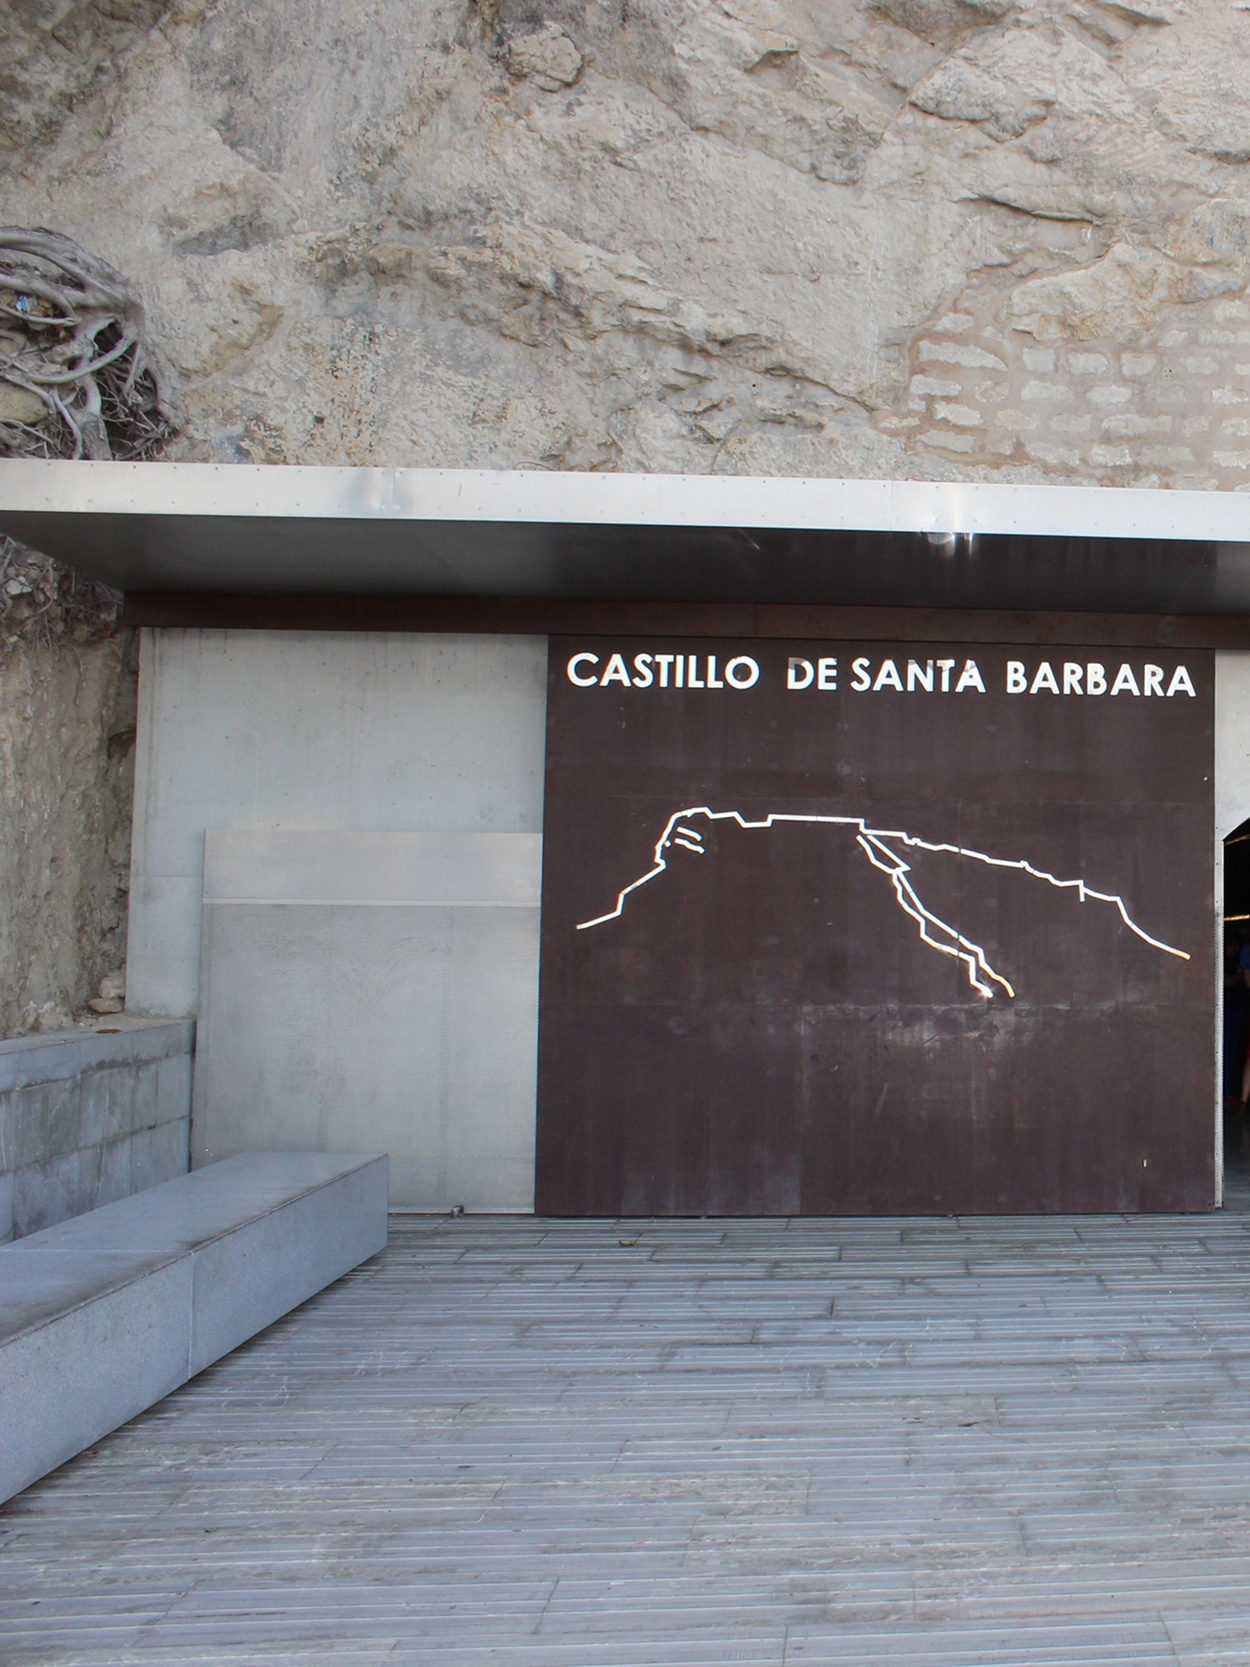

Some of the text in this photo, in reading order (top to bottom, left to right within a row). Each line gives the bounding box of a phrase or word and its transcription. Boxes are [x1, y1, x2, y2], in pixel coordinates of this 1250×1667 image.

[566, 651, 1198, 698] CASTILLO DE SANTA BARBARA
